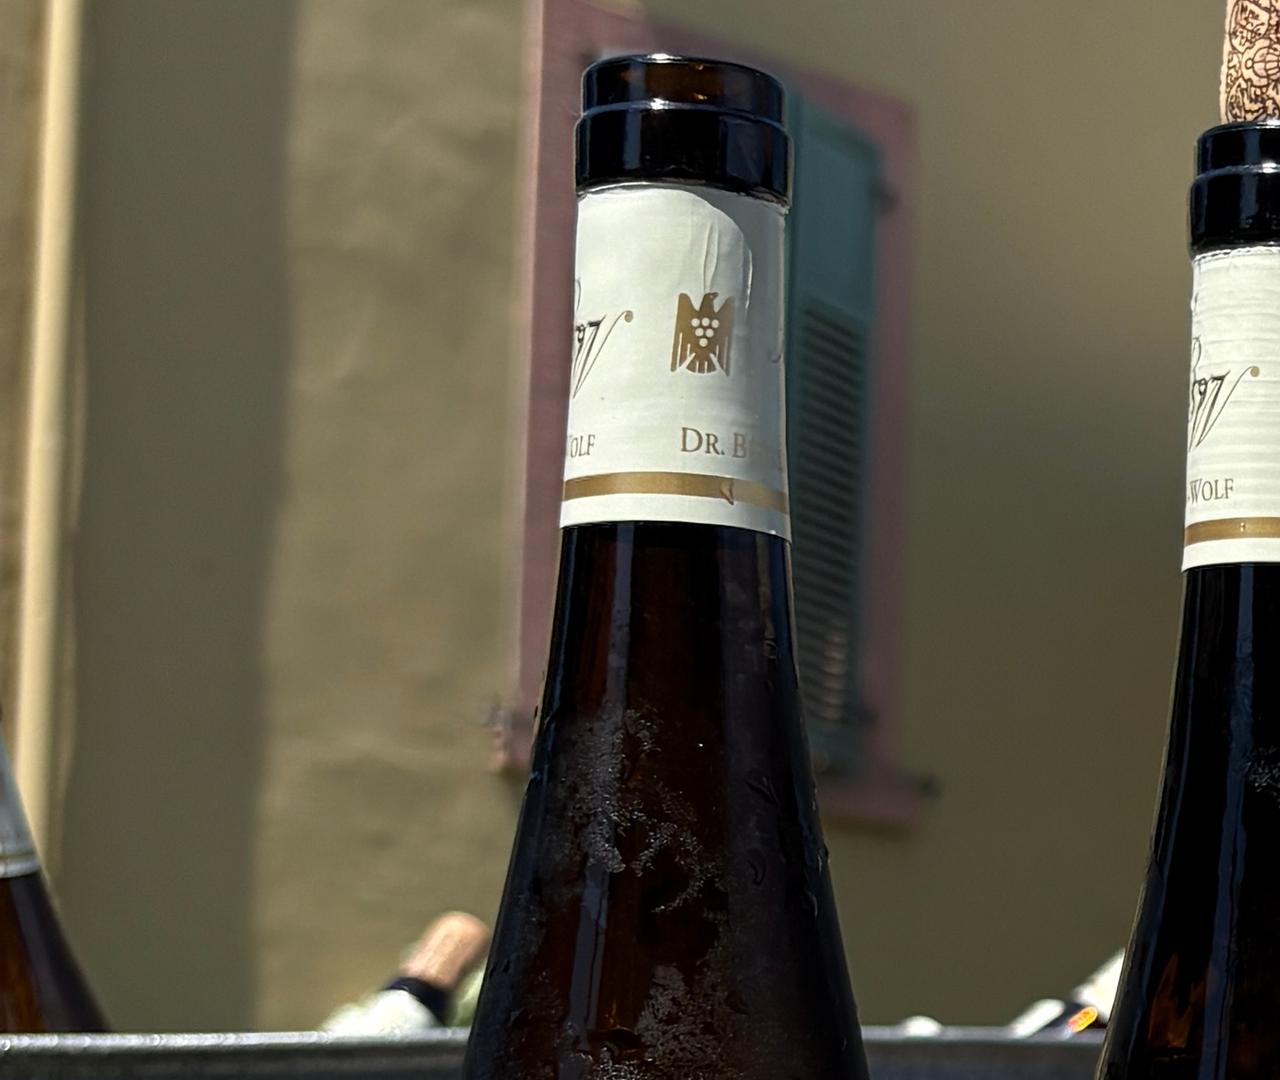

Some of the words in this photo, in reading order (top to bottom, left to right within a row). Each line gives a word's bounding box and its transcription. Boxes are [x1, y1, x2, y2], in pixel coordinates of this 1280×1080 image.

[570, 434, 596, 459] OLF
[680, 427, 726, 456] DR.
[1189, 477, 1235, 505] WOLF
